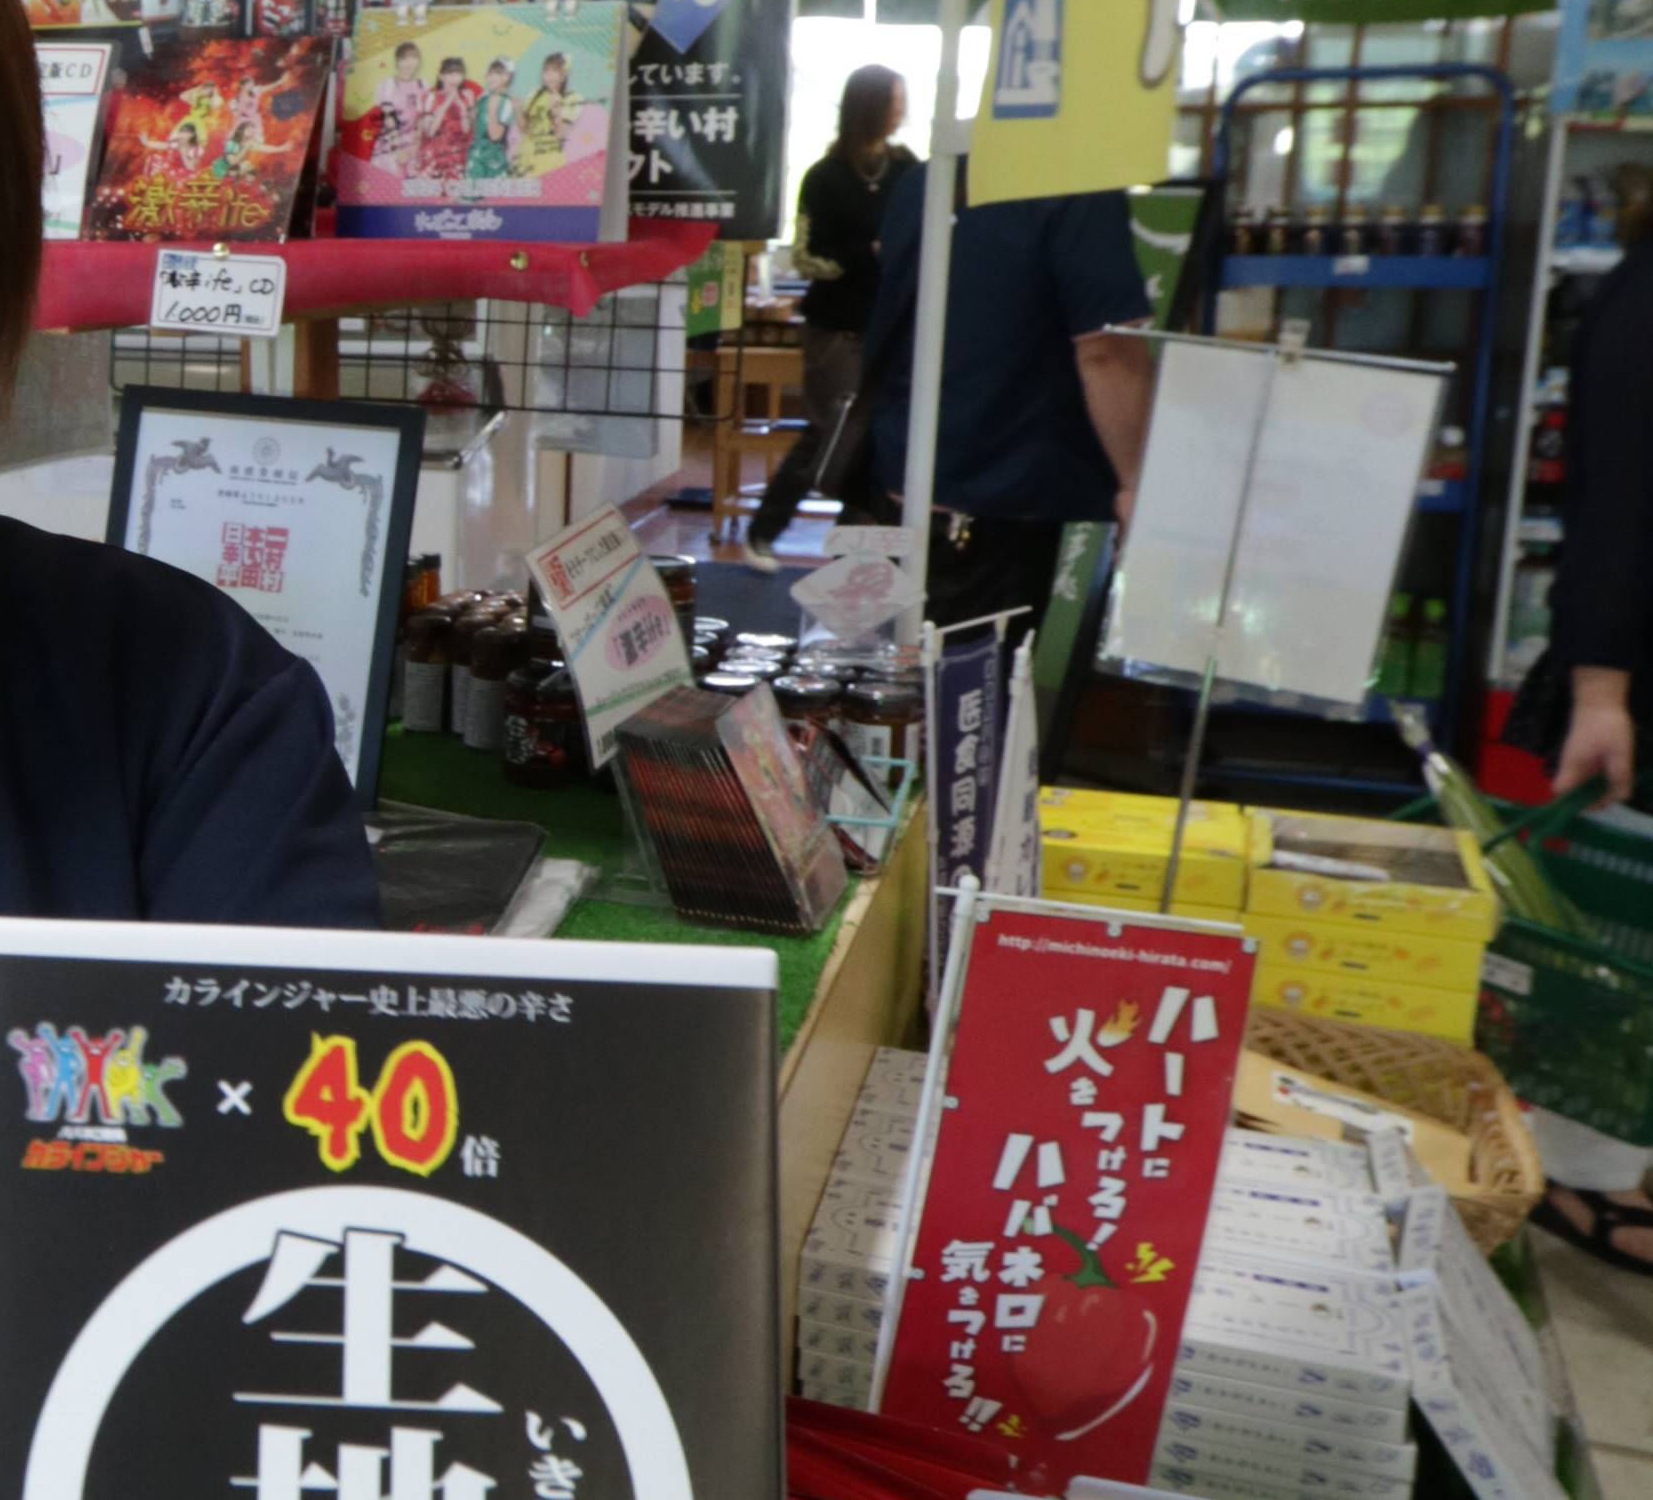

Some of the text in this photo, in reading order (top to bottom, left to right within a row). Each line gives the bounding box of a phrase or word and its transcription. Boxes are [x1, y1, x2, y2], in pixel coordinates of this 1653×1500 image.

[629, 105, 740, 144] 辛い村
[249, 277, 276, 296] CD
[996, 932, 1234, 975] http://michinoeki-hirata.com/
[1142, 984, 1220, 1179] ハートに
[992, 1133, 1067, 1353] ハバネロに
